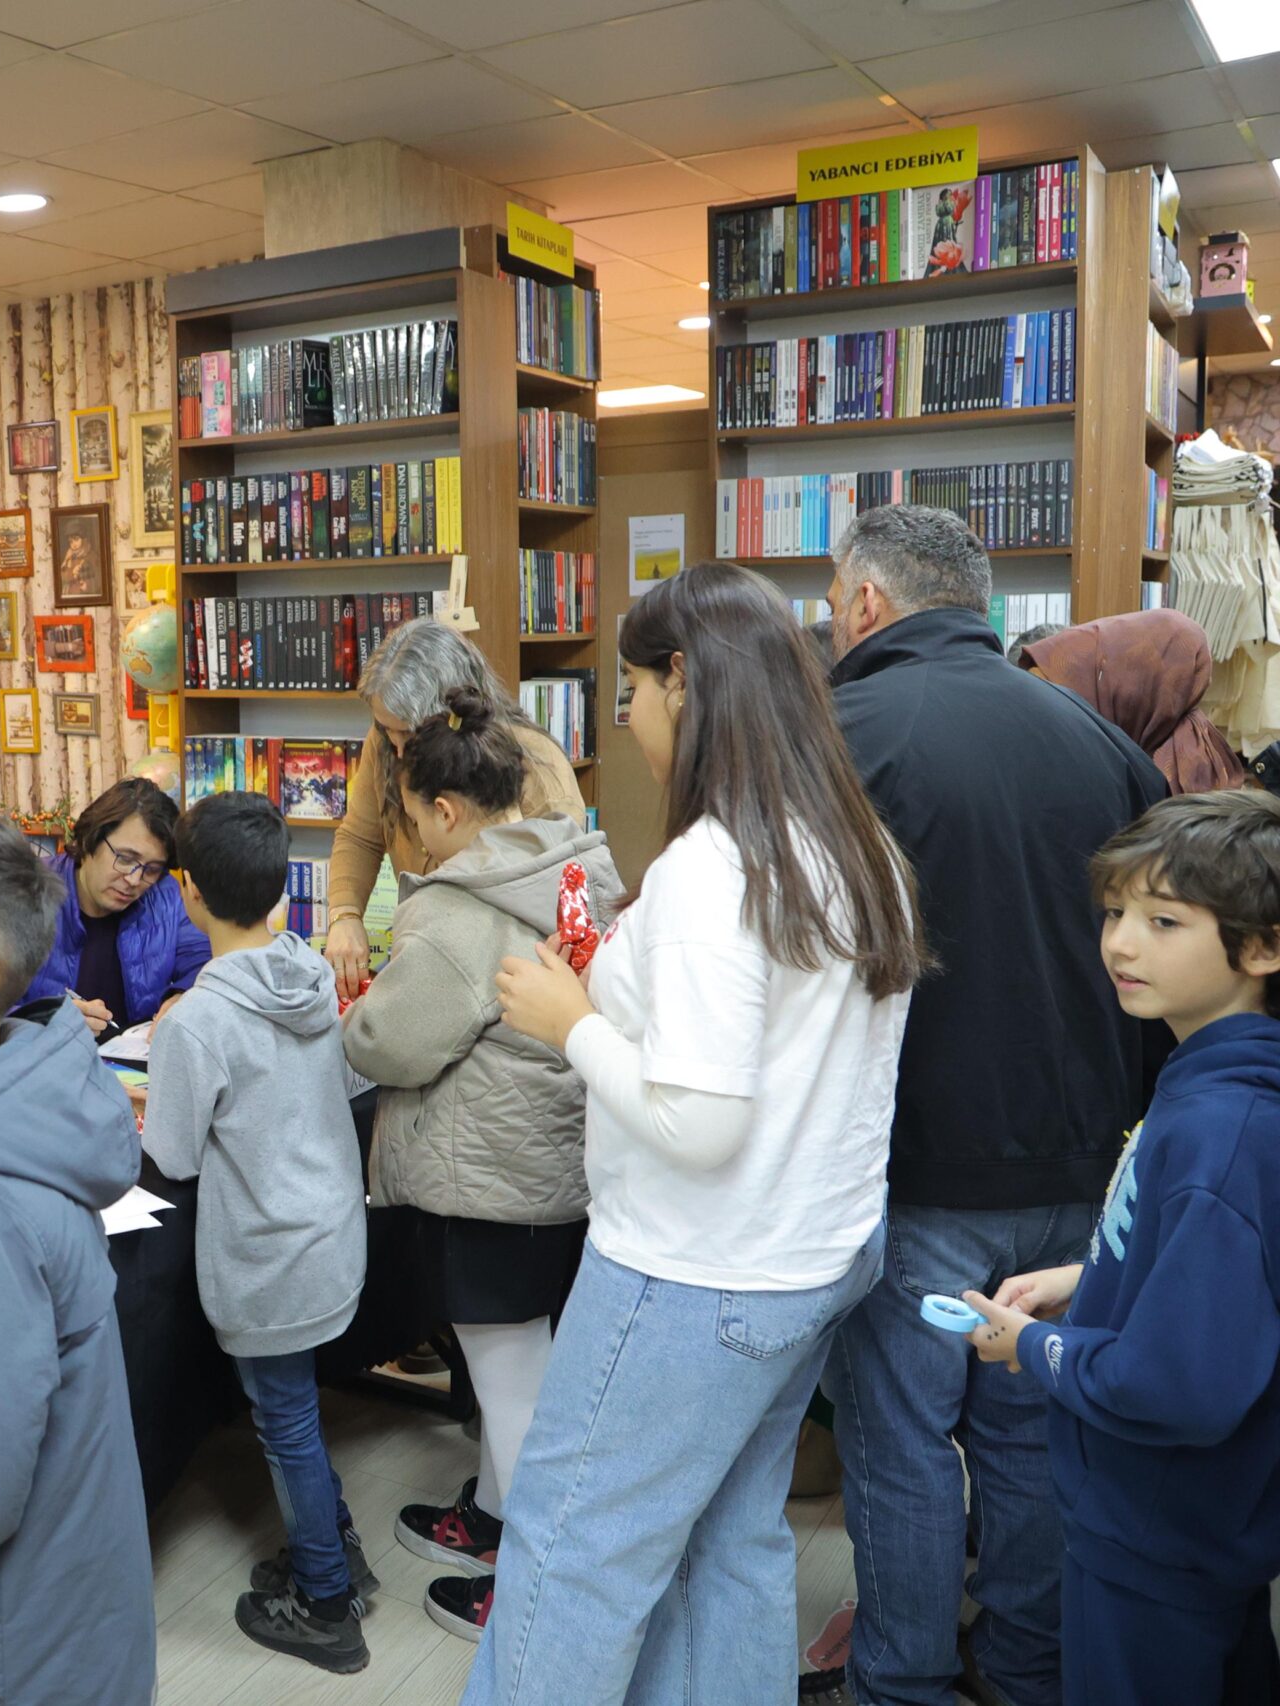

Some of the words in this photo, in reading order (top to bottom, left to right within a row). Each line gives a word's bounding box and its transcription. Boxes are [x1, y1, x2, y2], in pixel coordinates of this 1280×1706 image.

[809, 162, 879, 182] YABANCI
[885, 149, 965, 171] EDEBİYAT
[332, 348, 341, 385] MERLIN
[332, 475, 341, 500] KING
[398, 465, 406, 485] DAN
[232, 483, 241, 509] KING
[263, 481, 271, 505] KING
[358, 470, 366, 510] STEPHEN
[398, 489, 406, 524] BROWN
[233, 522, 244, 546] Kule
